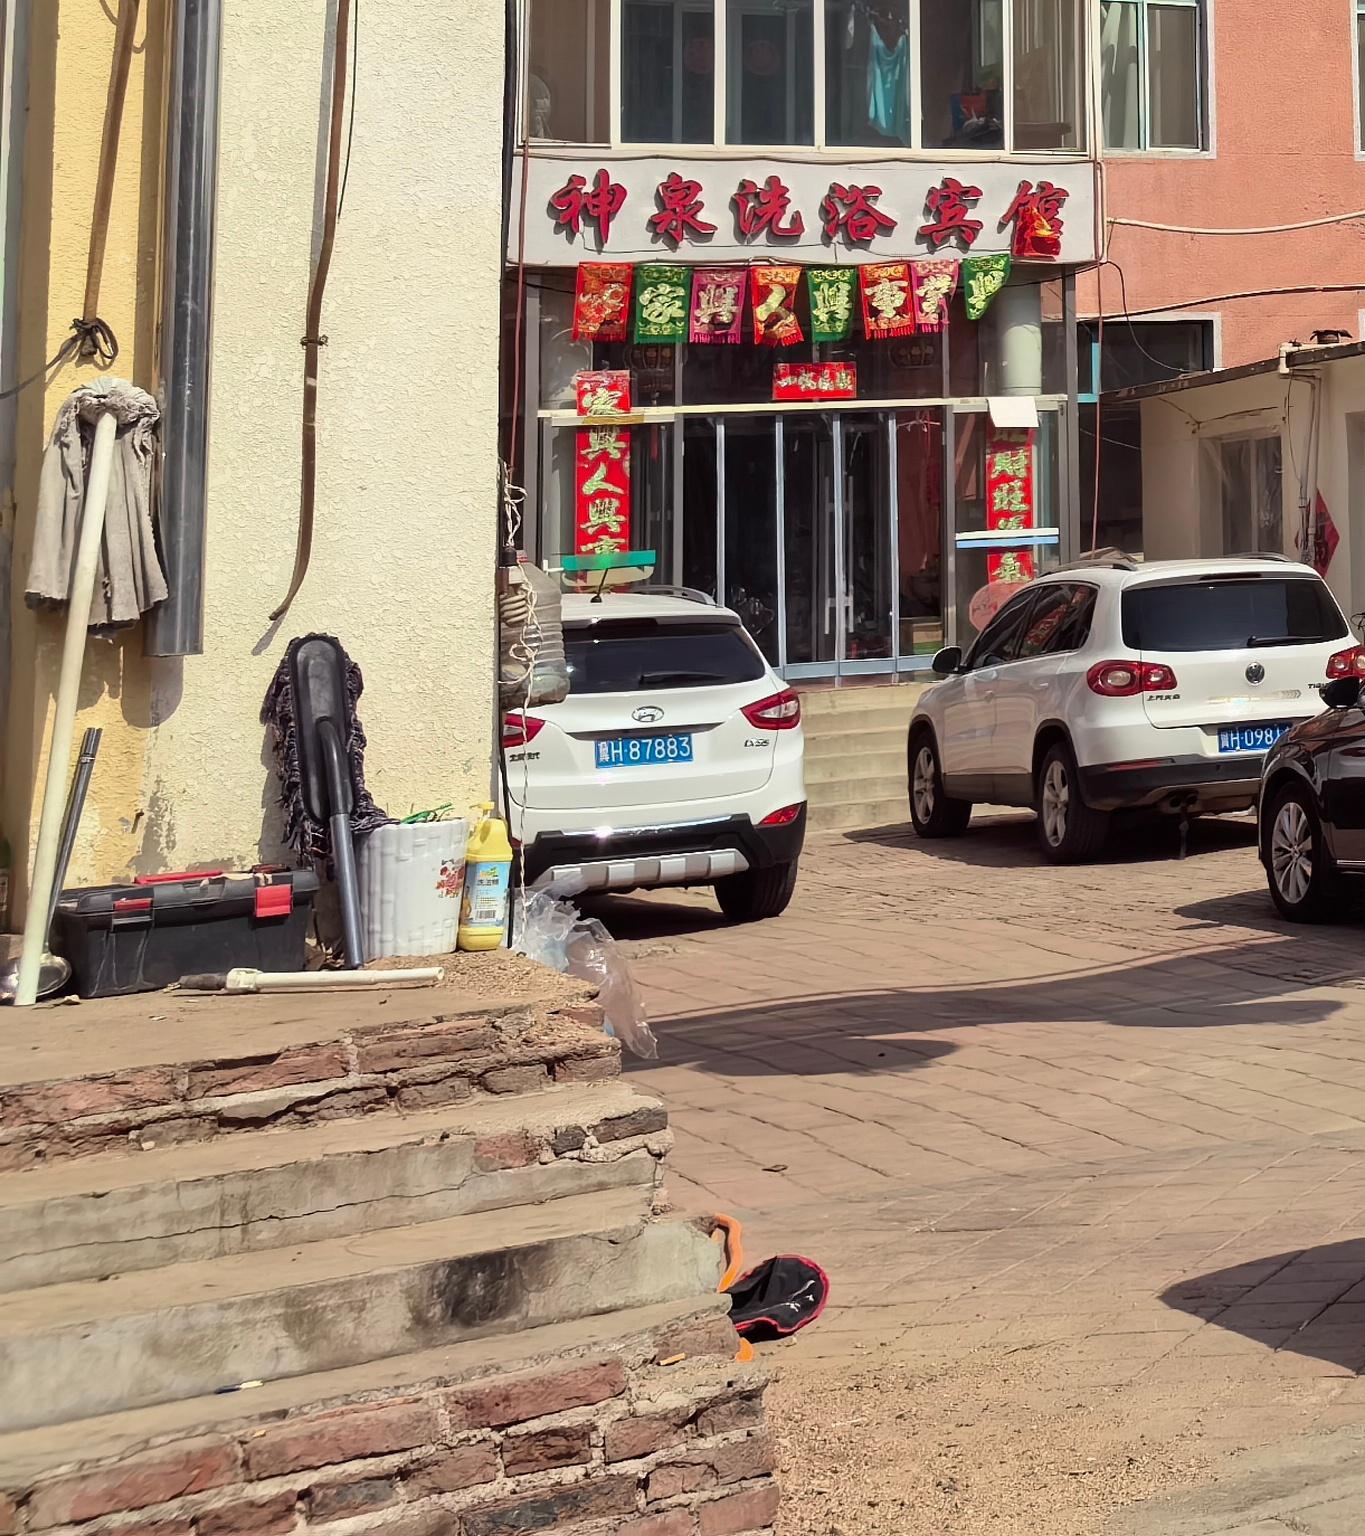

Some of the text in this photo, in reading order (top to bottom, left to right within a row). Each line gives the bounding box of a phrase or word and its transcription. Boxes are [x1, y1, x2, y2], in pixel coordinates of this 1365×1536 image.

[550, 169, 1070, 252] 神泉洗浴宾馆
